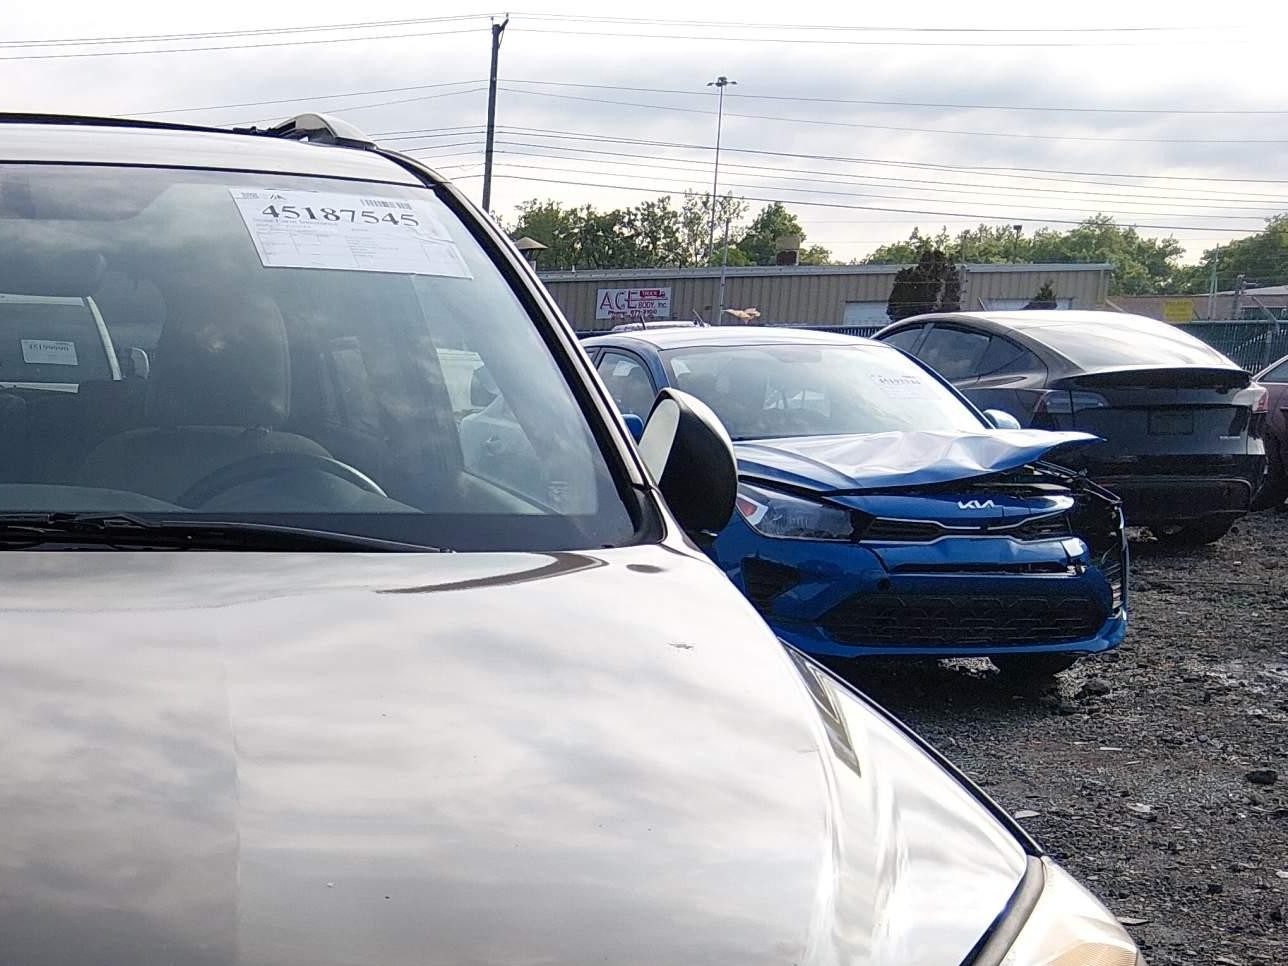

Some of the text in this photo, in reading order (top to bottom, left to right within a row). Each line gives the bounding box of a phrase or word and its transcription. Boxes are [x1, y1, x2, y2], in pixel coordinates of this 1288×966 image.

[261, 204, 420, 228] 45187545
[599, 289, 639, 311] ACE
[958, 499, 995, 510] KIA
